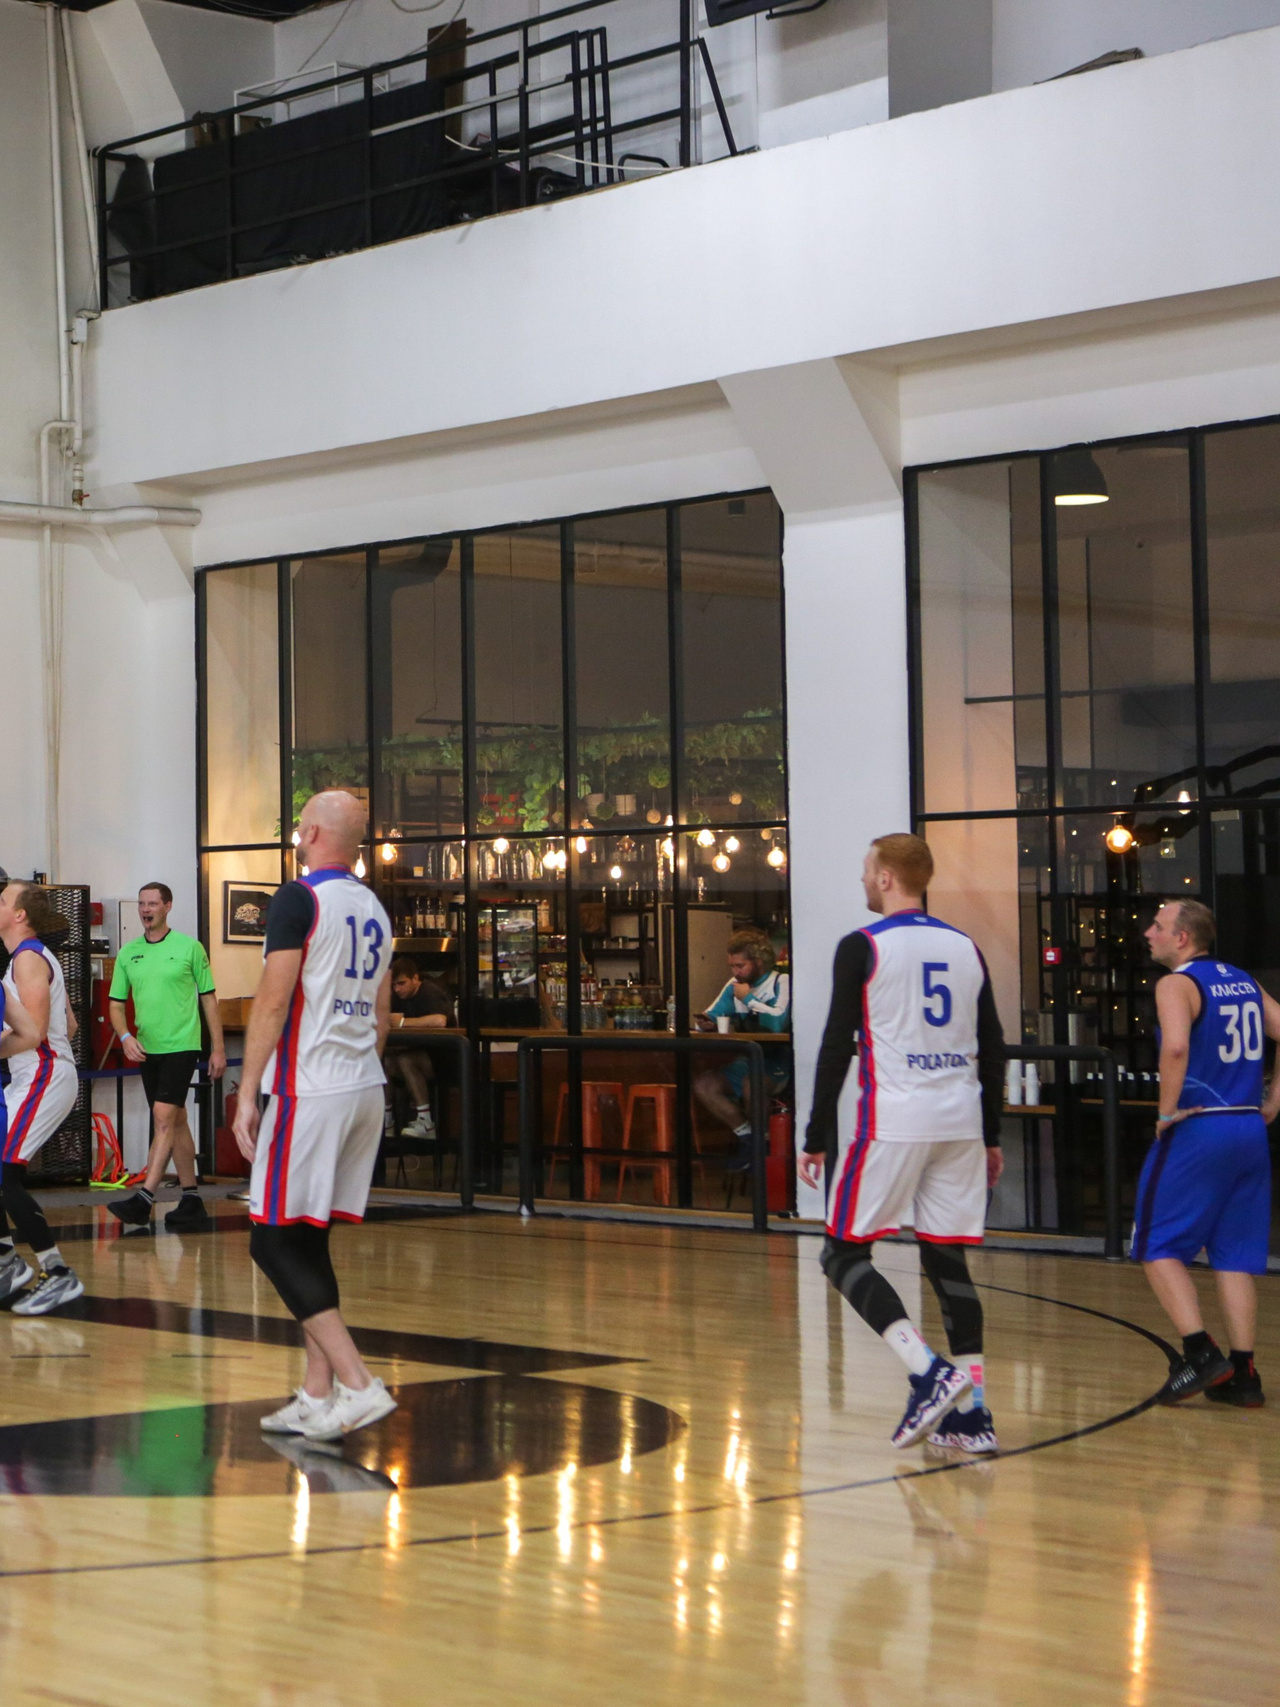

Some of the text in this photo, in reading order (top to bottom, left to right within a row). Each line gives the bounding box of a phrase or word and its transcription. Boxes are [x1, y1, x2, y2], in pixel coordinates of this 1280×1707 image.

[344, 915, 384, 980] 13
[922, 961, 952, 1027] 5
[1218, 1001, 1263, 1064] 30
